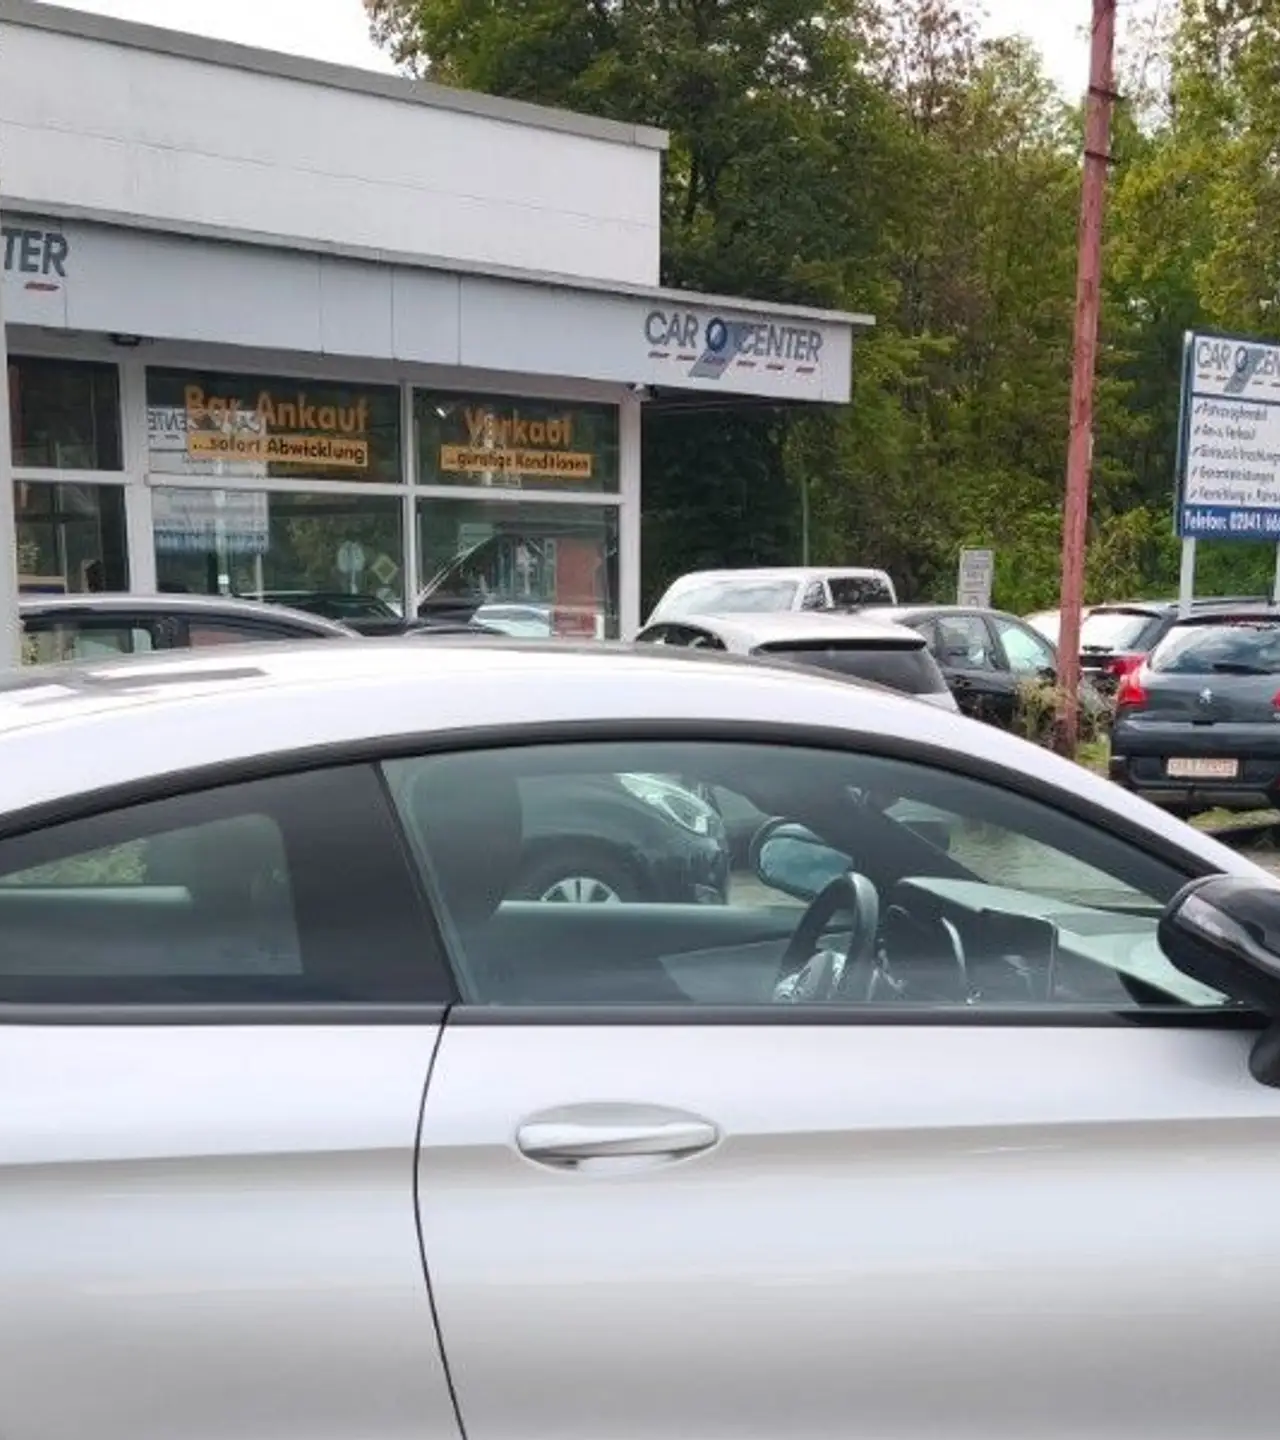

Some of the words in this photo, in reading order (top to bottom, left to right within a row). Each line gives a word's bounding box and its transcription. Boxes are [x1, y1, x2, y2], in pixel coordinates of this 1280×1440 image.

[645, 309, 699, 348] CAR
[736, 322, 824, 362] CENTER
[1197, 341, 1232, 371] CAR
[257, 391, 368, 433] Ankauf
[464, 406, 574, 447] Verkauf
[266, 440, 365, 465] Abwicklung
[516, 453, 589, 470] Konditionen
